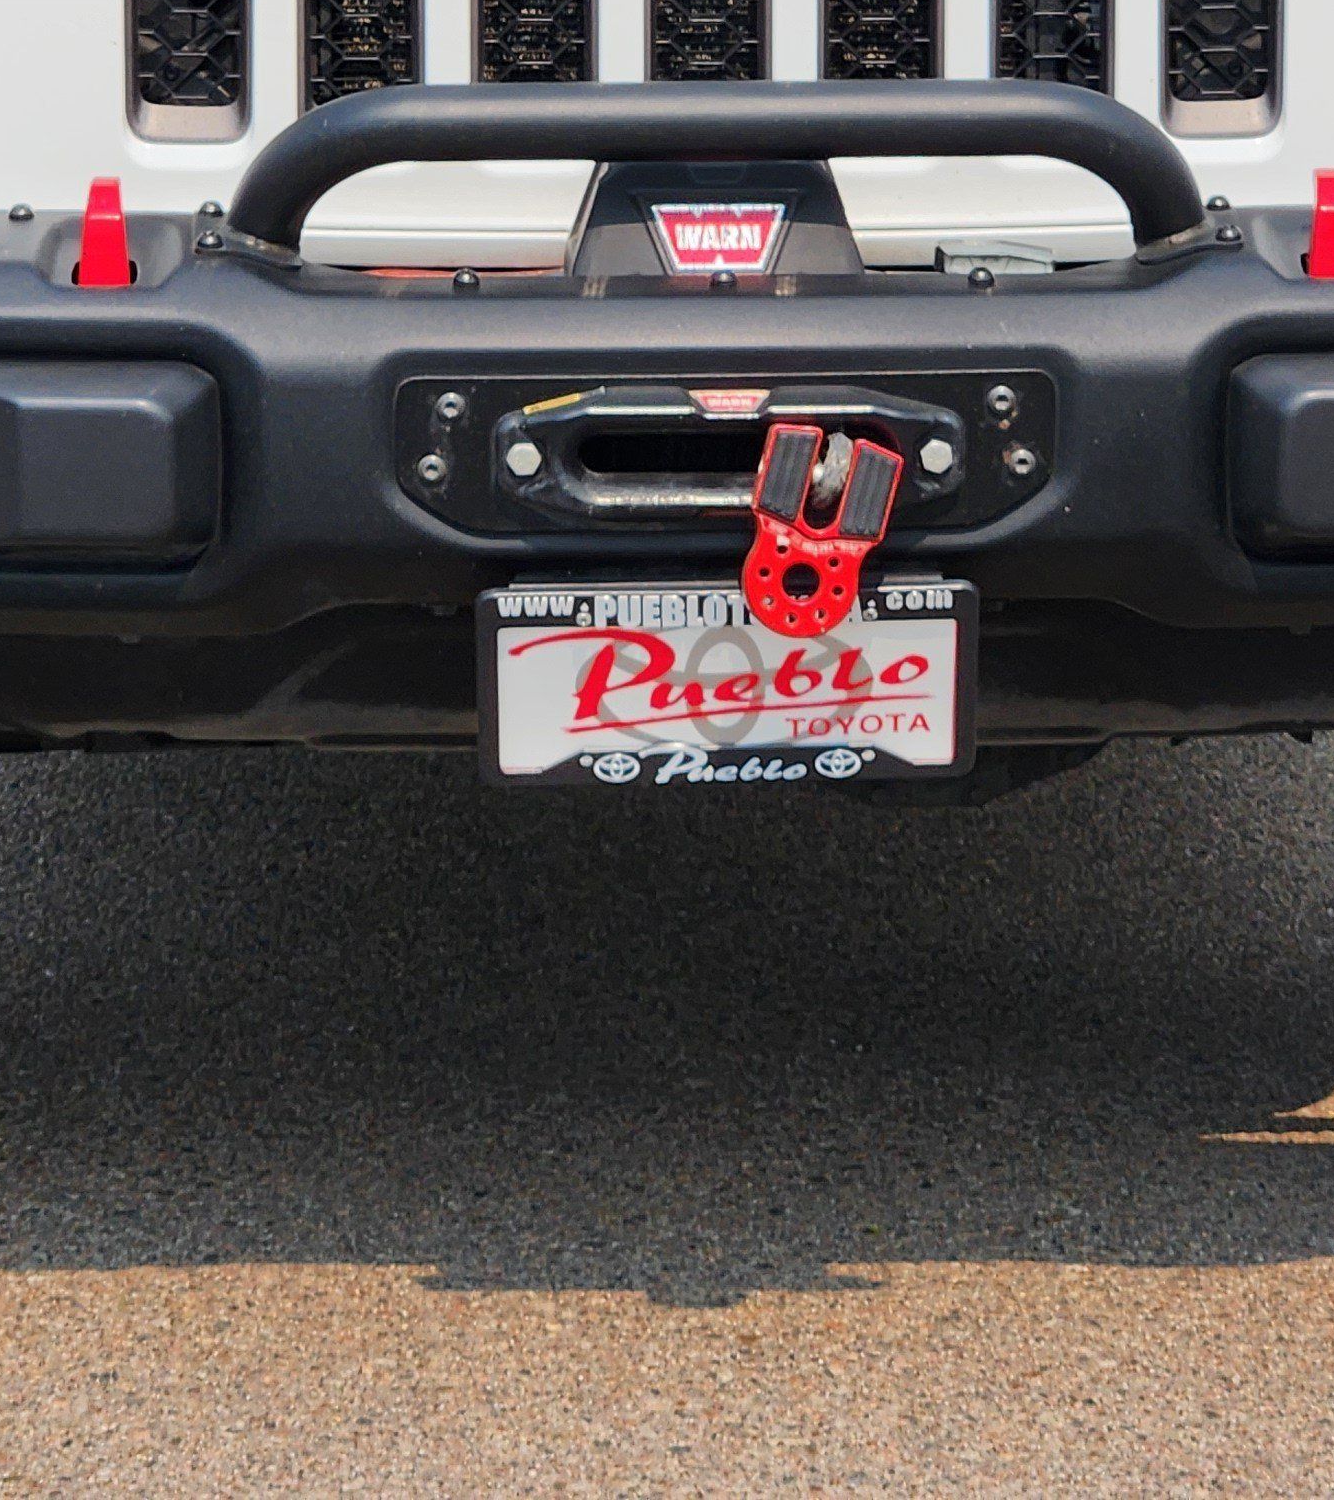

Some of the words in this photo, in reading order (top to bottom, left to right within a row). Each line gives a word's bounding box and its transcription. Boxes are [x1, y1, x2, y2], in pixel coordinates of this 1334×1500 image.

[675, 224, 761, 250] WARN
[508, 627, 930, 721] Pueblo
[785, 713, 931, 739] TOYOTA
[638, 741, 808, 784] Pueblo
